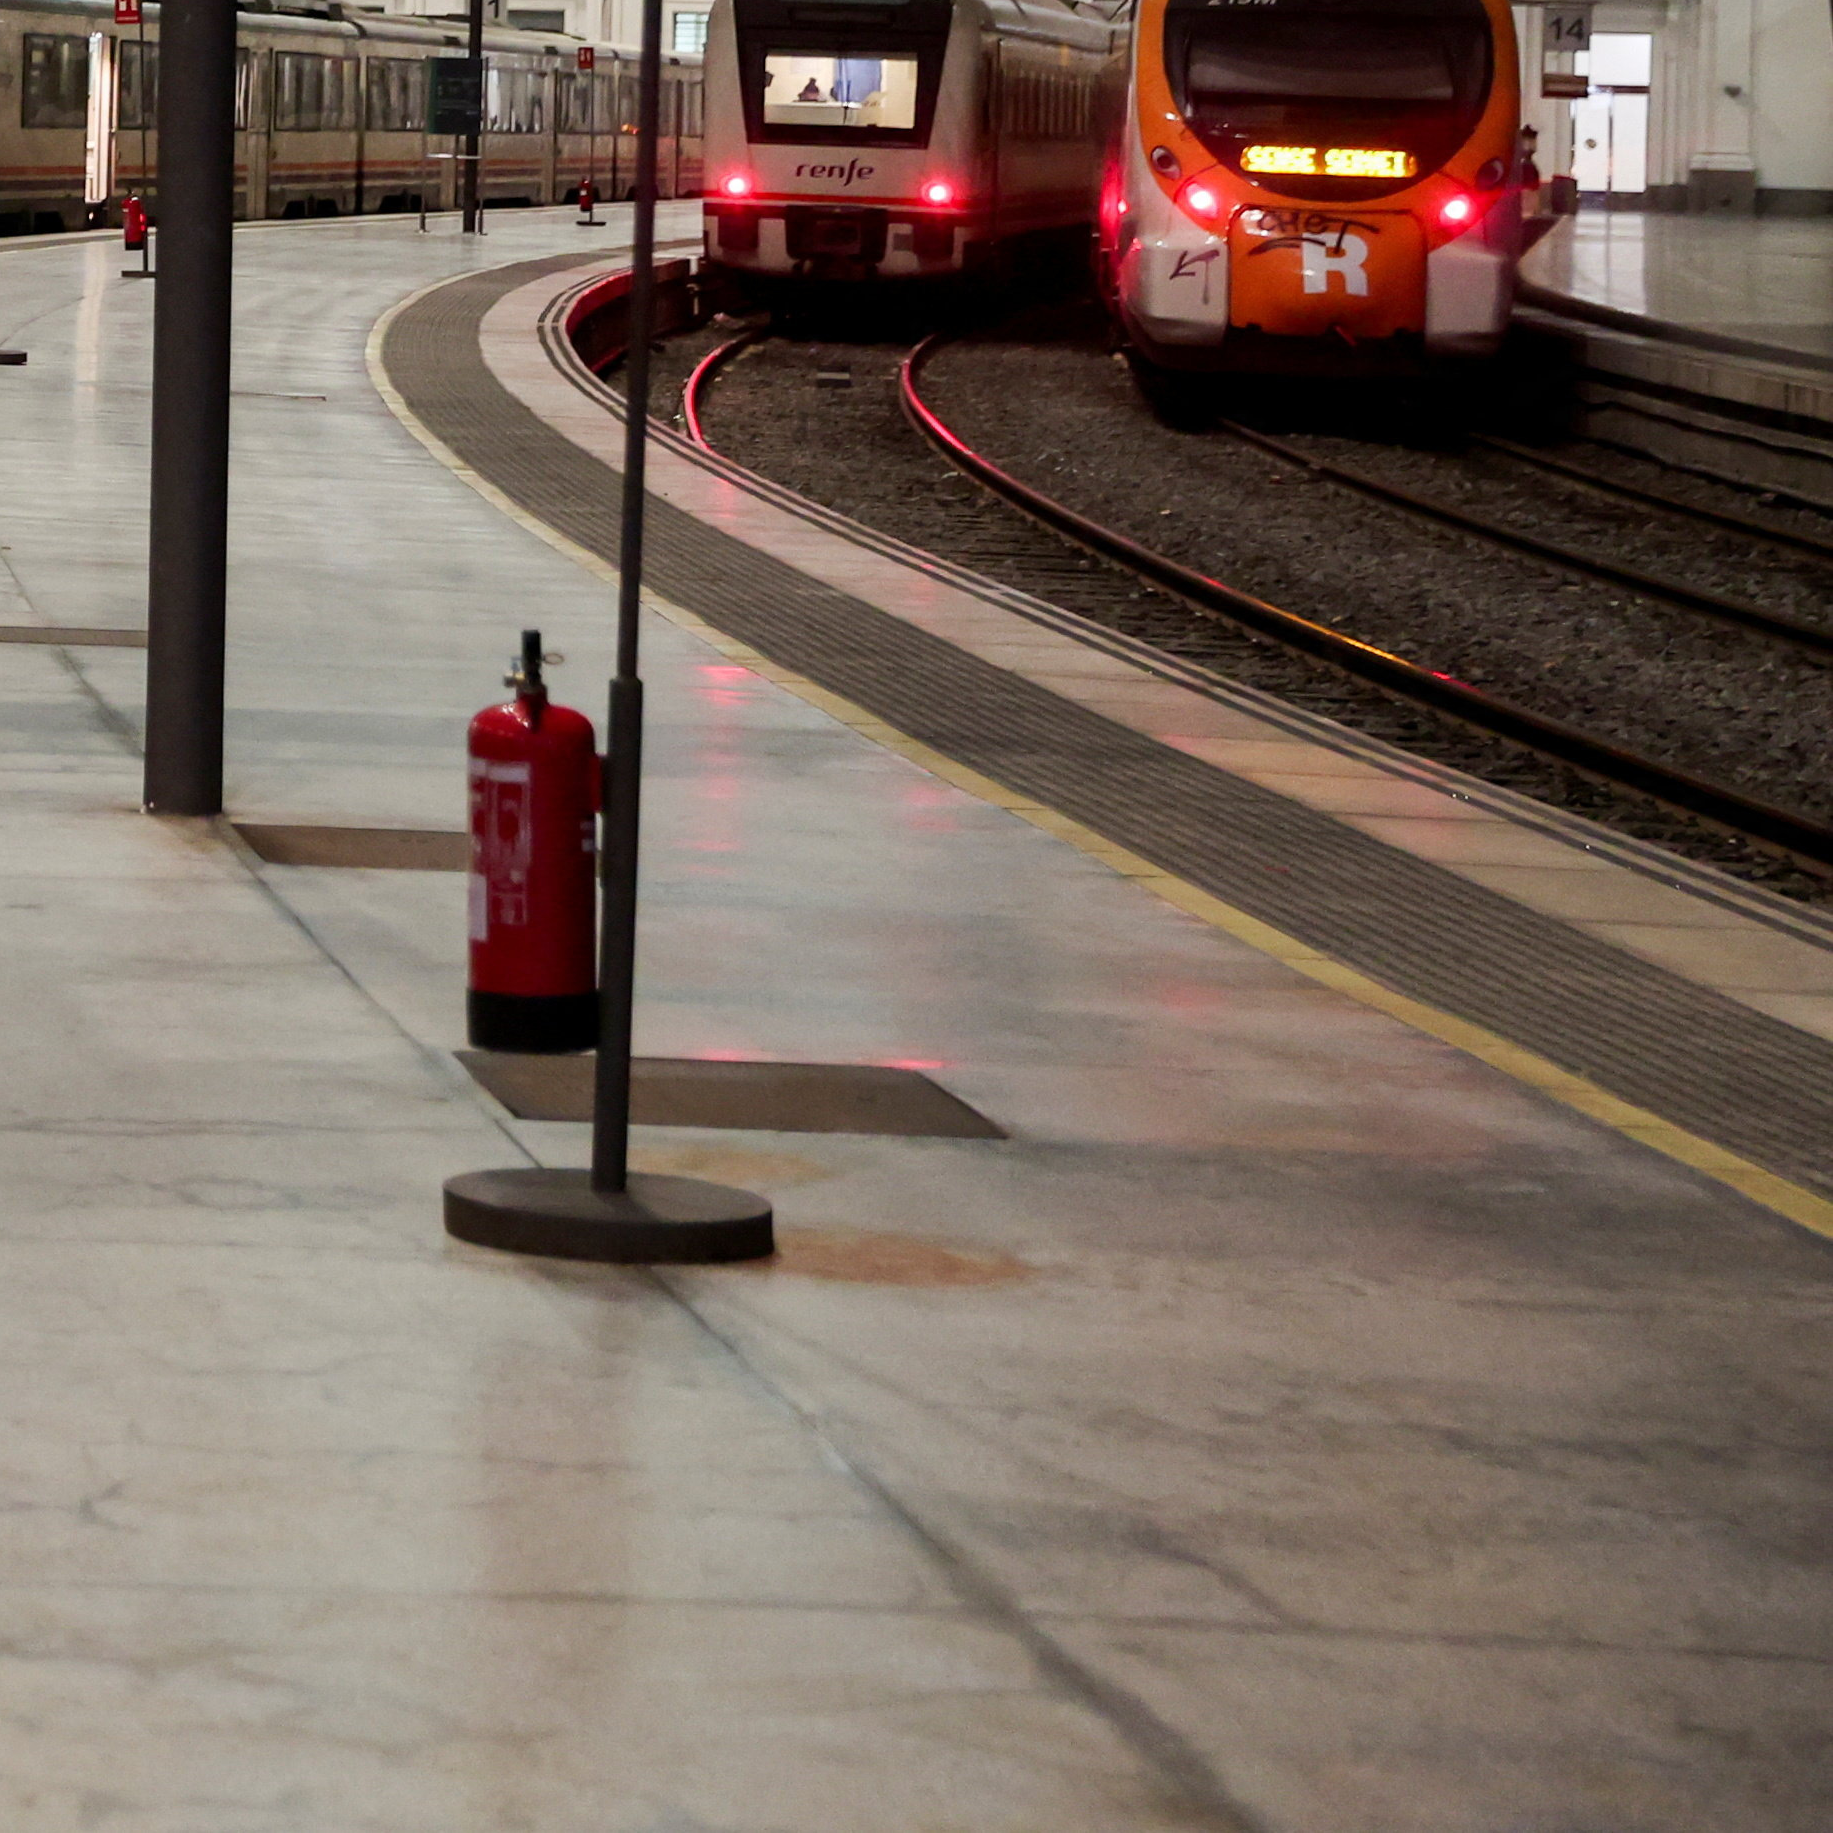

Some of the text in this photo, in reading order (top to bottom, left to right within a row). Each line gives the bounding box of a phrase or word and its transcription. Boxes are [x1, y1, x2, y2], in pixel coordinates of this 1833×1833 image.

[1548, 17, 1585, 41] 14
[795, 157, 875, 187] renfe
[1301, 231, 1369, 297] R
